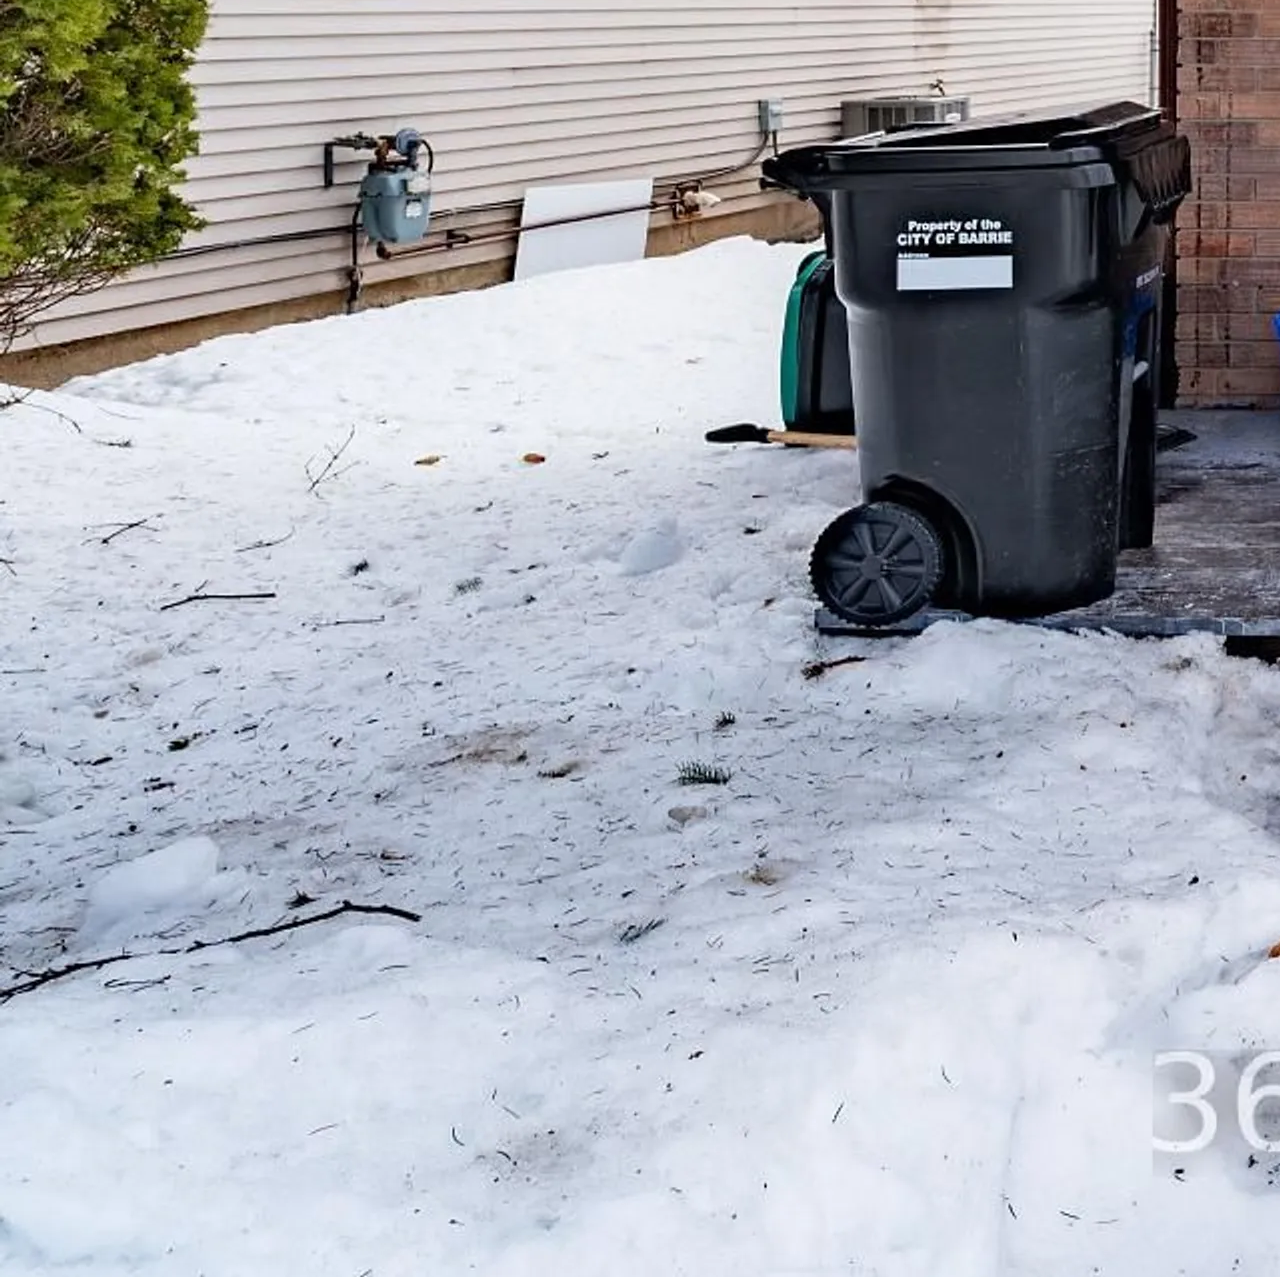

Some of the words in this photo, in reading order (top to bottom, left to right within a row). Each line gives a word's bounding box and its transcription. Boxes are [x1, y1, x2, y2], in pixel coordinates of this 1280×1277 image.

[908, 220, 961, 233] Property
[964, 219, 979, 231] of
[980, 219, 1002, 231] the
[897, 233, 933, 246] CITY
[936, 232, 956, 245] OF
[958, 231, 1014, 244] BARRIE
